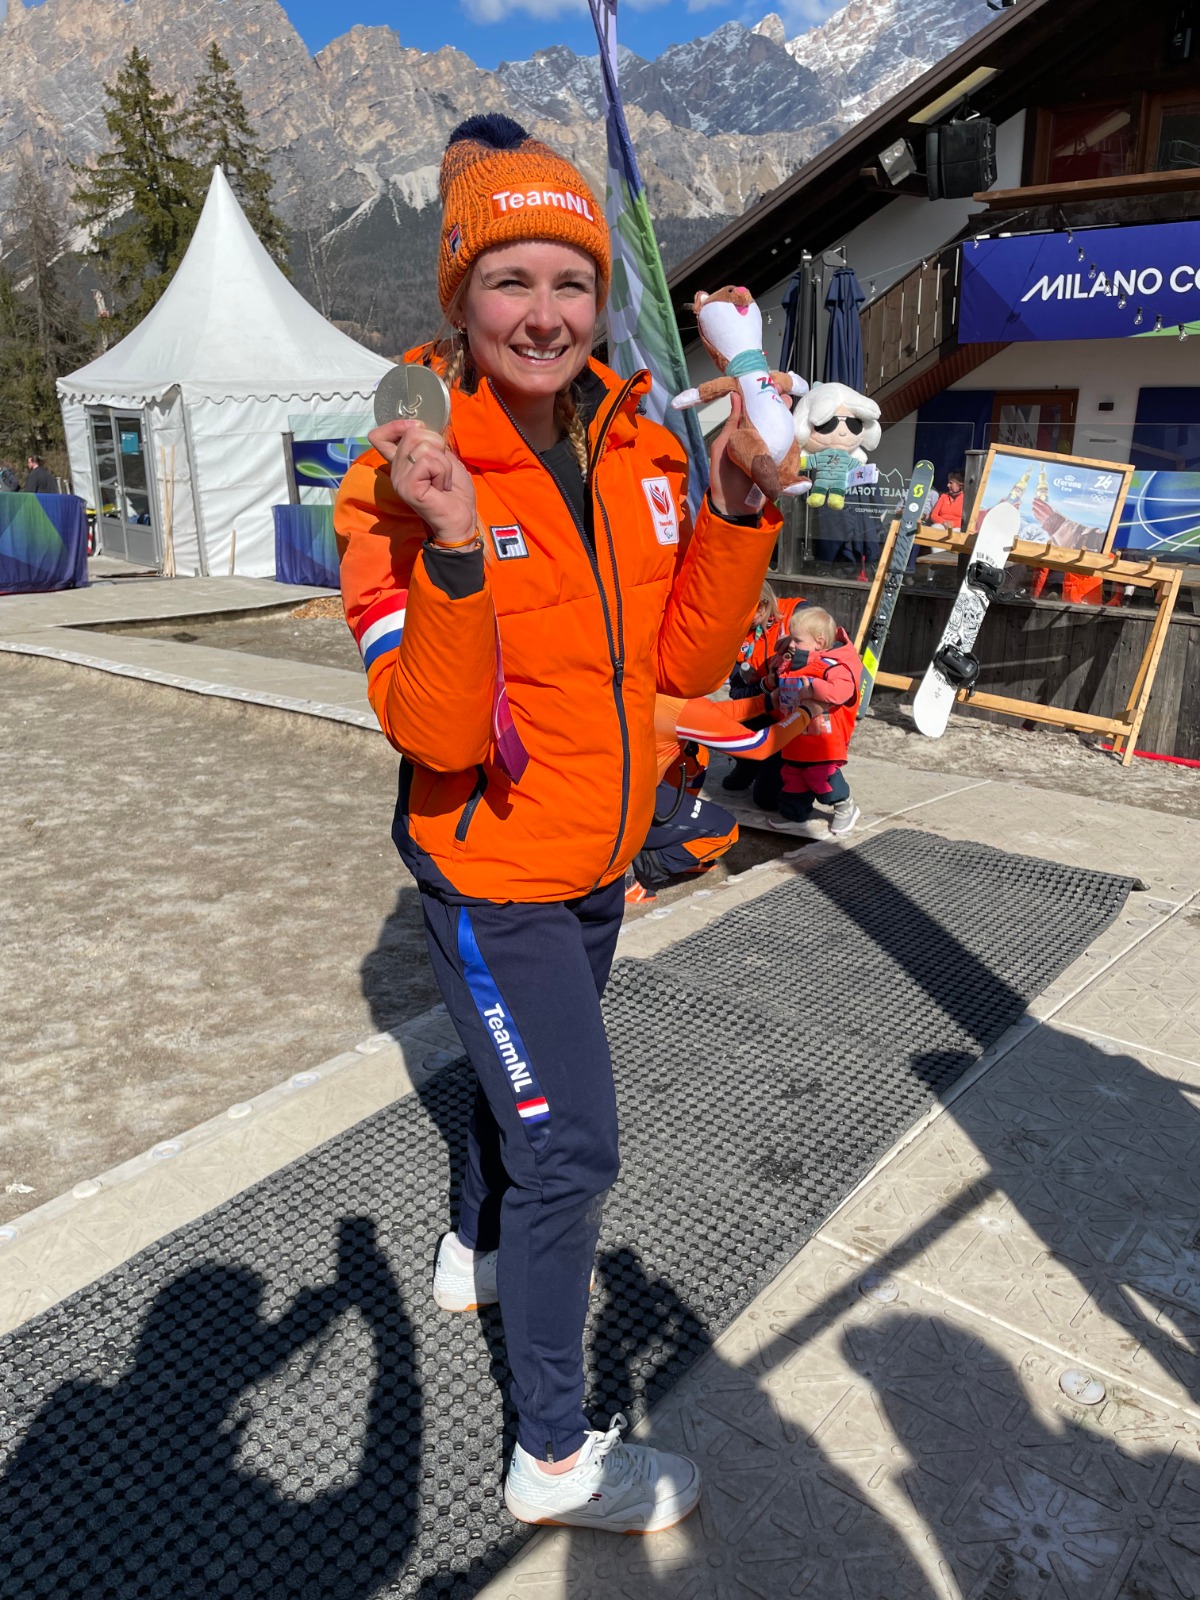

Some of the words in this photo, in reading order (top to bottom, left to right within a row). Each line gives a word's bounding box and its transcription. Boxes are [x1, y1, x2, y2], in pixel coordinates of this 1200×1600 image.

[492, 190, 594, 222] TeamNL
[1020, 267, 1163, 302] MILANO
[1169, 265, 1200, 293] C
[1053, 477, 1082, 489] Corona
[483, 1002, 533, 1093] TeamNL
